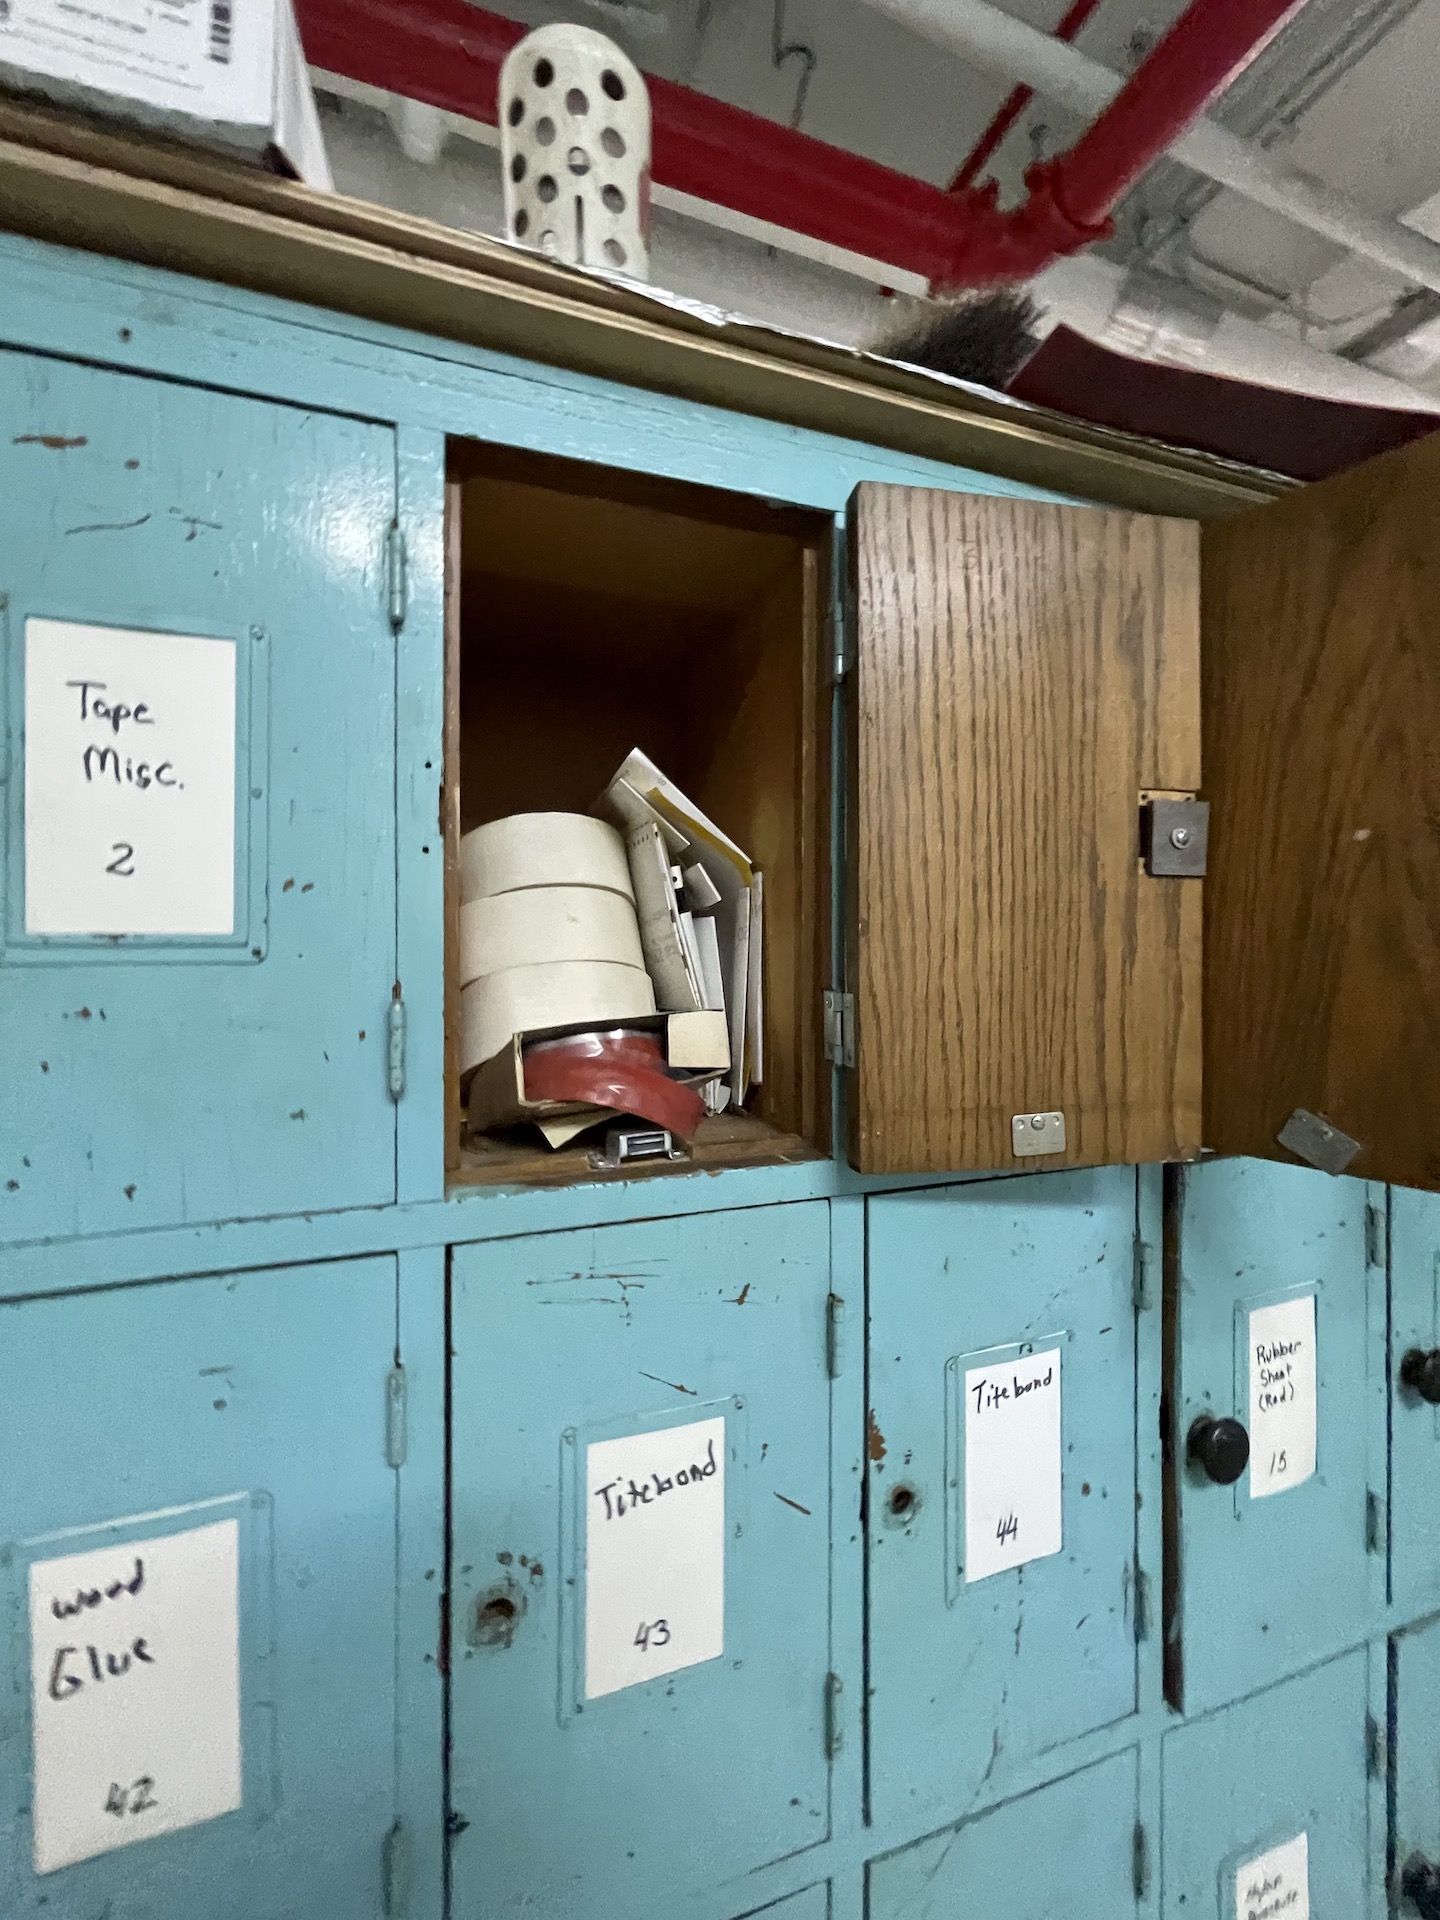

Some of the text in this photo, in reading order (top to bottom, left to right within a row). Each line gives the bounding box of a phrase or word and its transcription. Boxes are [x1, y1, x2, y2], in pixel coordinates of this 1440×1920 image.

[66, 680, 154, 734] Tape
[83, 745, 184, 788] Misc.
[105, 843, 134, 875] 2
[1257, 1341, 1301, 1365] Rubber
[971, 1367, 1052, 1414] Titebond
[595, 1439, 716, 1520] Titebond
[997, 1511, 1018, 1546] 44
[633, 1619, 670, 1651] 43
[49, 1638, 155, 1700] Glue
[105, 1776, 158, 1817] 42
